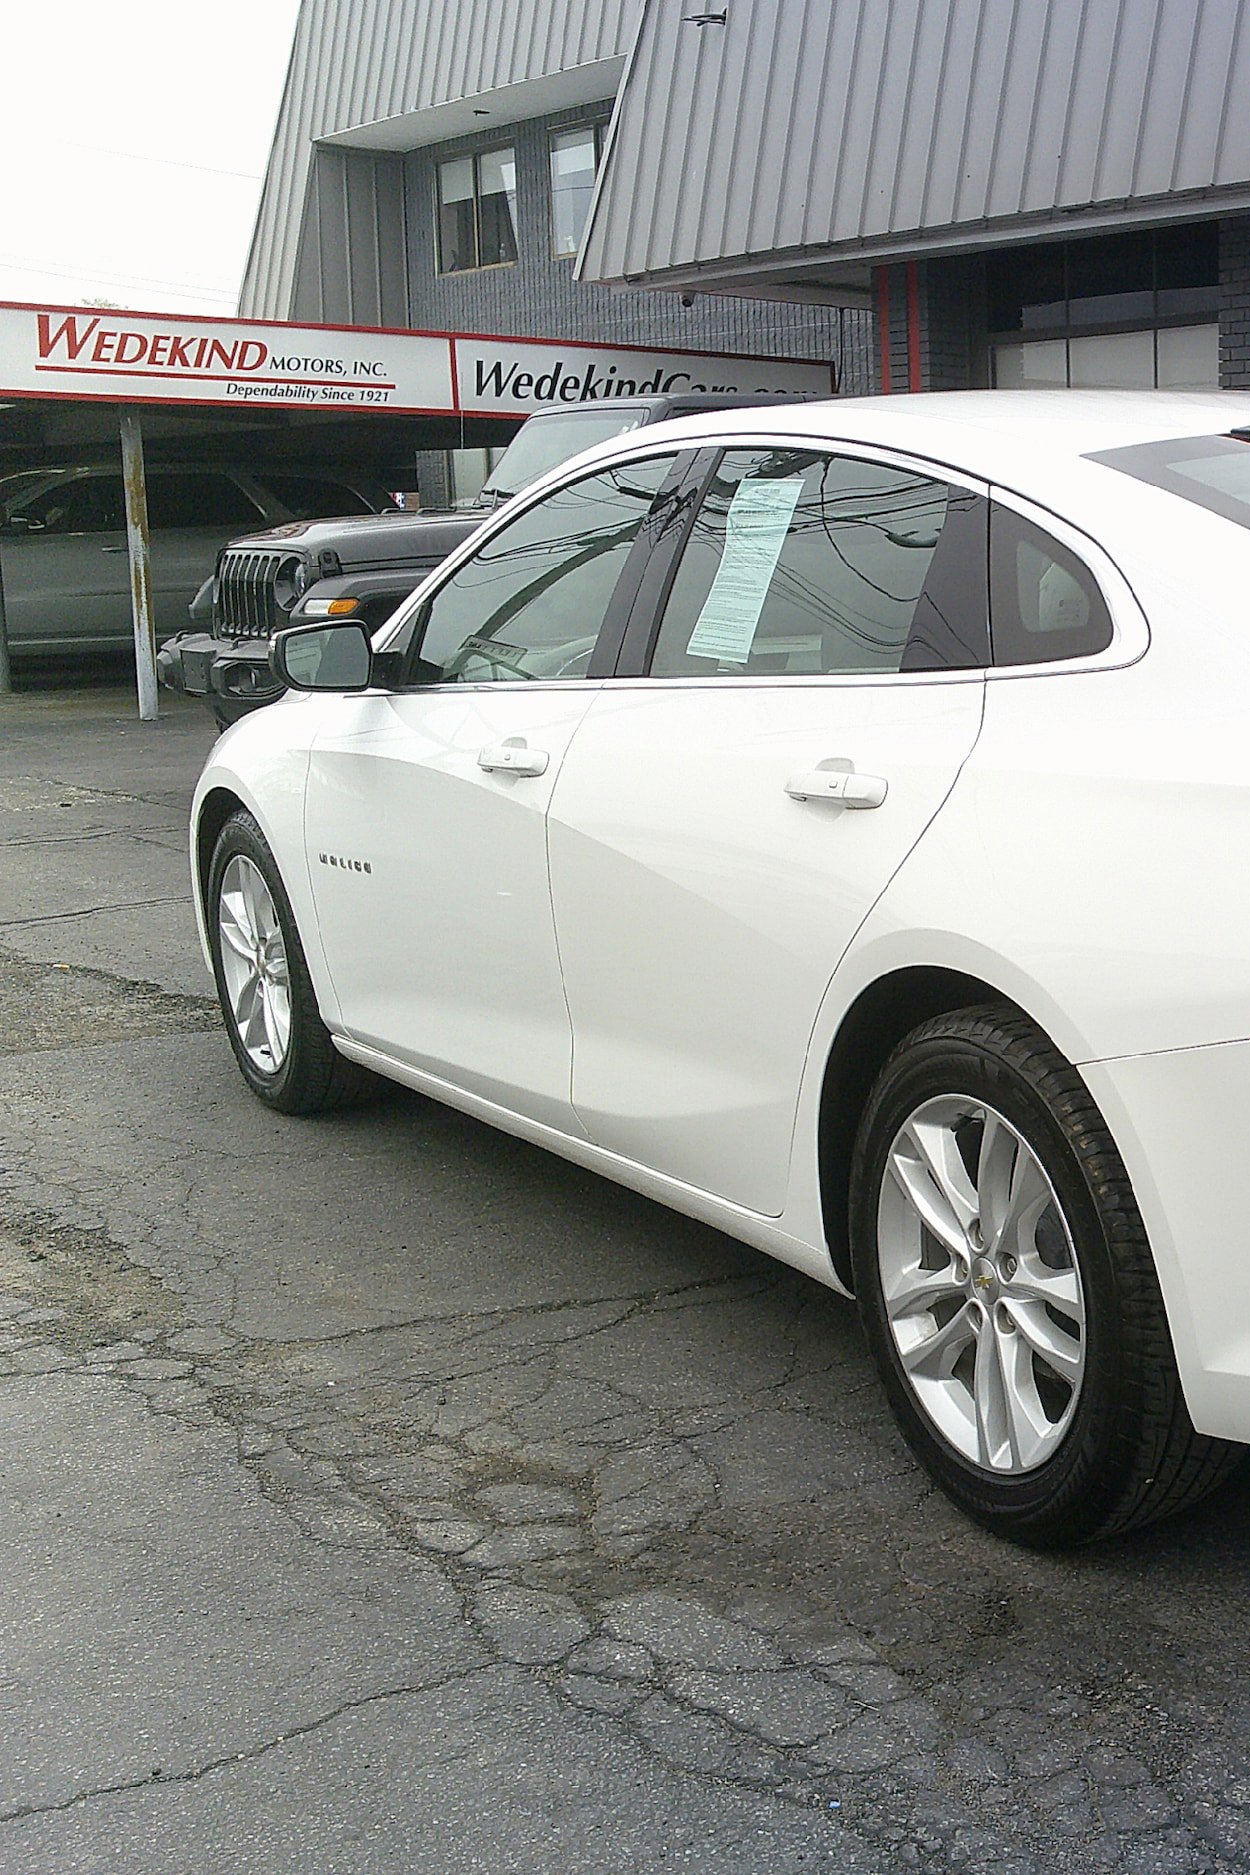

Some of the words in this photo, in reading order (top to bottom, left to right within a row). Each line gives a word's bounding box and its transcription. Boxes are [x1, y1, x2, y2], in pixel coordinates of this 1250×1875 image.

[36, 314, 268, 371] WEDEKIND
[269, 356, 347, 376] MOTORS,
[353, 361, 388, 377] INC.
[226, 382, 318, 402] Dependability
[320, 387, 355, 401] Since
[359, 390, 389, 402] 1921
[475, 359, 818, 402] WedekindC
